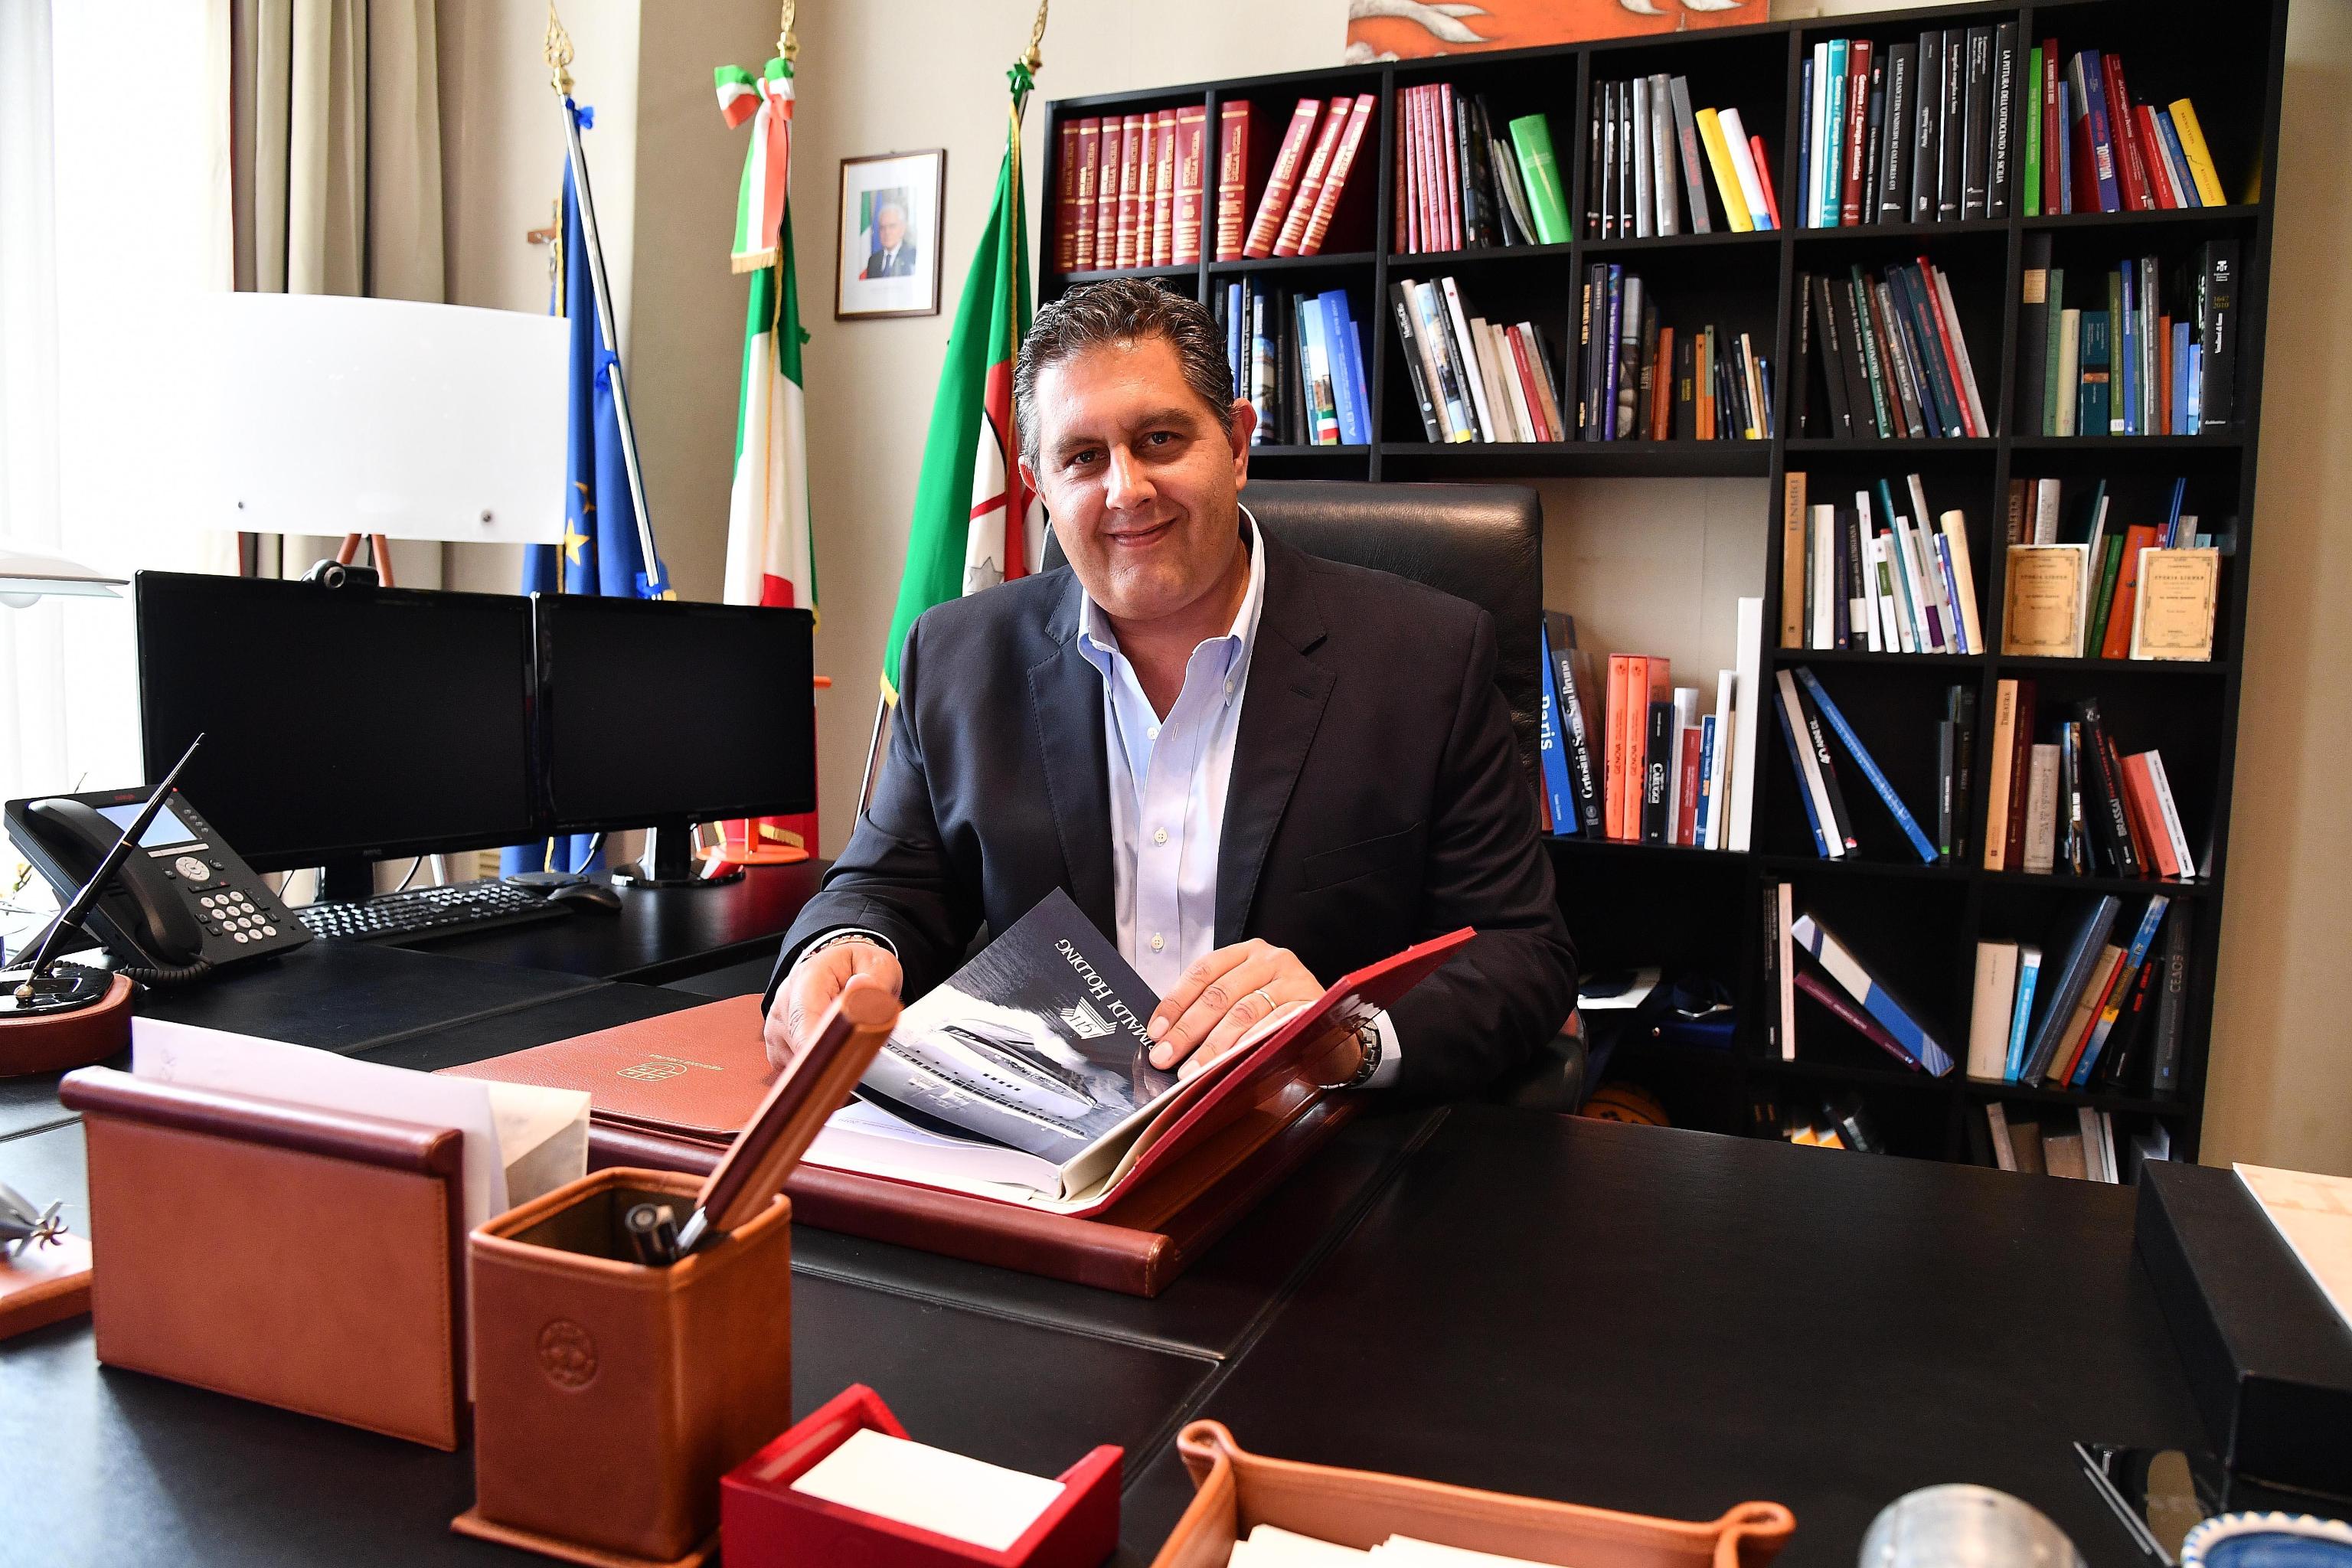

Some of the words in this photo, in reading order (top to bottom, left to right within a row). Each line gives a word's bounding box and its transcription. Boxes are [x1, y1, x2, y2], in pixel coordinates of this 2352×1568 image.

[1996, 160, 2004, 184] SICILIA
[2096, 143, 2112, 180] WARHOL
[1054, 937, 1115, 1001] HOLDING
